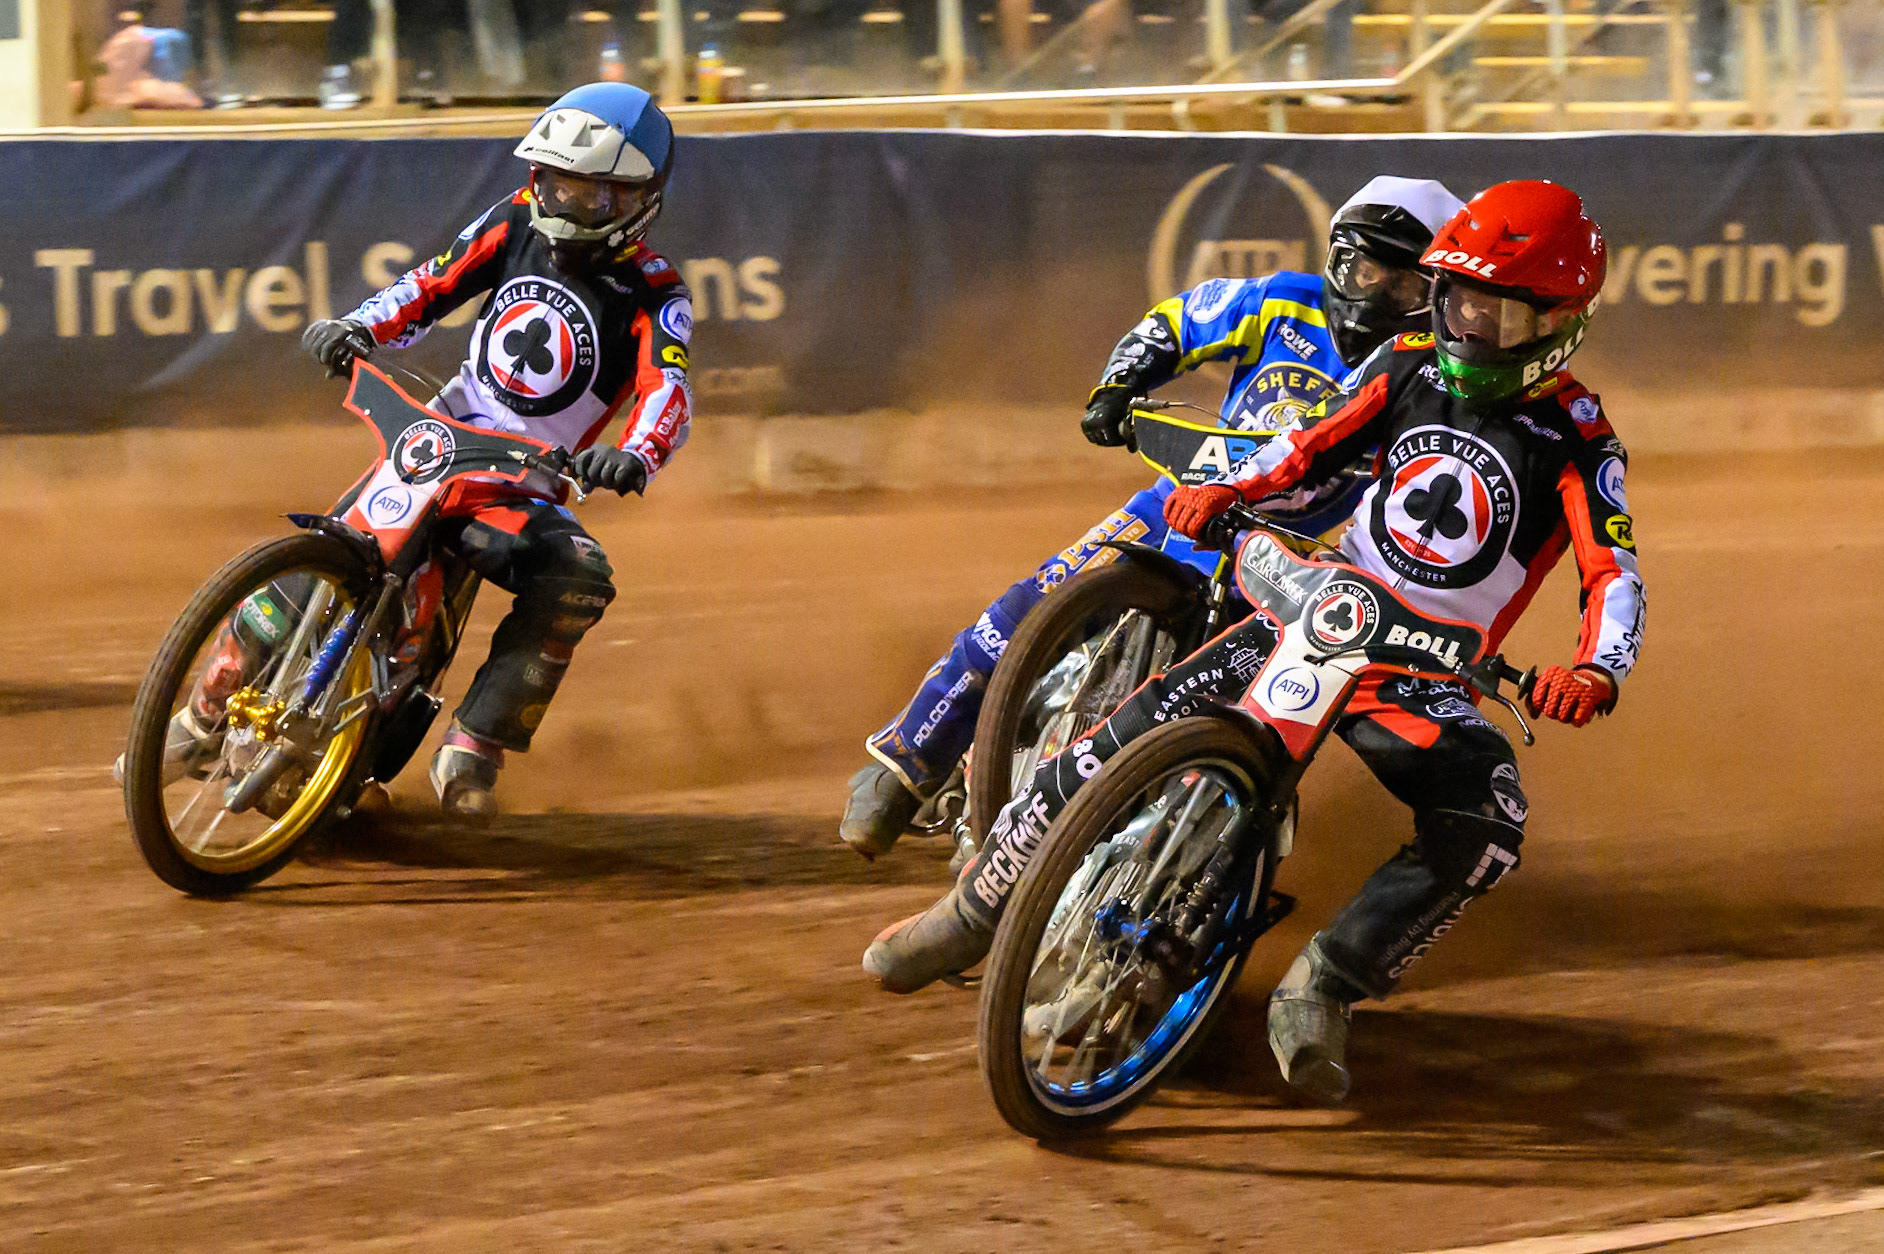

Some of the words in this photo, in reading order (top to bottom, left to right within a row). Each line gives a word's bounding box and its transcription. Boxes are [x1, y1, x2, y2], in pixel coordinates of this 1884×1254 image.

[1425, 249, 1497, 279] BOLL
[1601, 222, 1848, 327] vering
[34, 241, 332, 337] Travel
[495, 284, 539, 313] BELLE
[545, 289, 577, 318] VUE
[572, 322, 592, 366] ACES
[1277, 323, 1318, 357] ROWE
[1522, 326, 1585, 387] BOLL
[1257, 371, 1336, 399] SHEFF
[404, 423, 428, 440] BELLE
[430, 424, 445, 437] VUE
[1181, 472, 1206, 481] RACE
[1388, 435, 1440, 468] BELLE
[1452, 439, 1490, 469] VUE
[1487, 475, 1510, 524] ACES
[375, 496, 404, 514] ATPI
[1246, 553, 1308, 604] GARCAREK
[1381, 541, 1447, 582] MANCHESTER
[242, 599, 279, 639] OTOREX
[1315, 584, 1344, 602] BELLE
[1348, 585, 1366, 600] VUE
[1364, 600, 1375, 624] ACES
[1384, 624, 1461, 663] BOLL
[1153, 668, 1224, 722] EASTERN
[1170, 684, 1219, 721] POIT
[1276, 678, 1310, 703] ATPI
[973, 790, 1053, 909] BECKHFF
